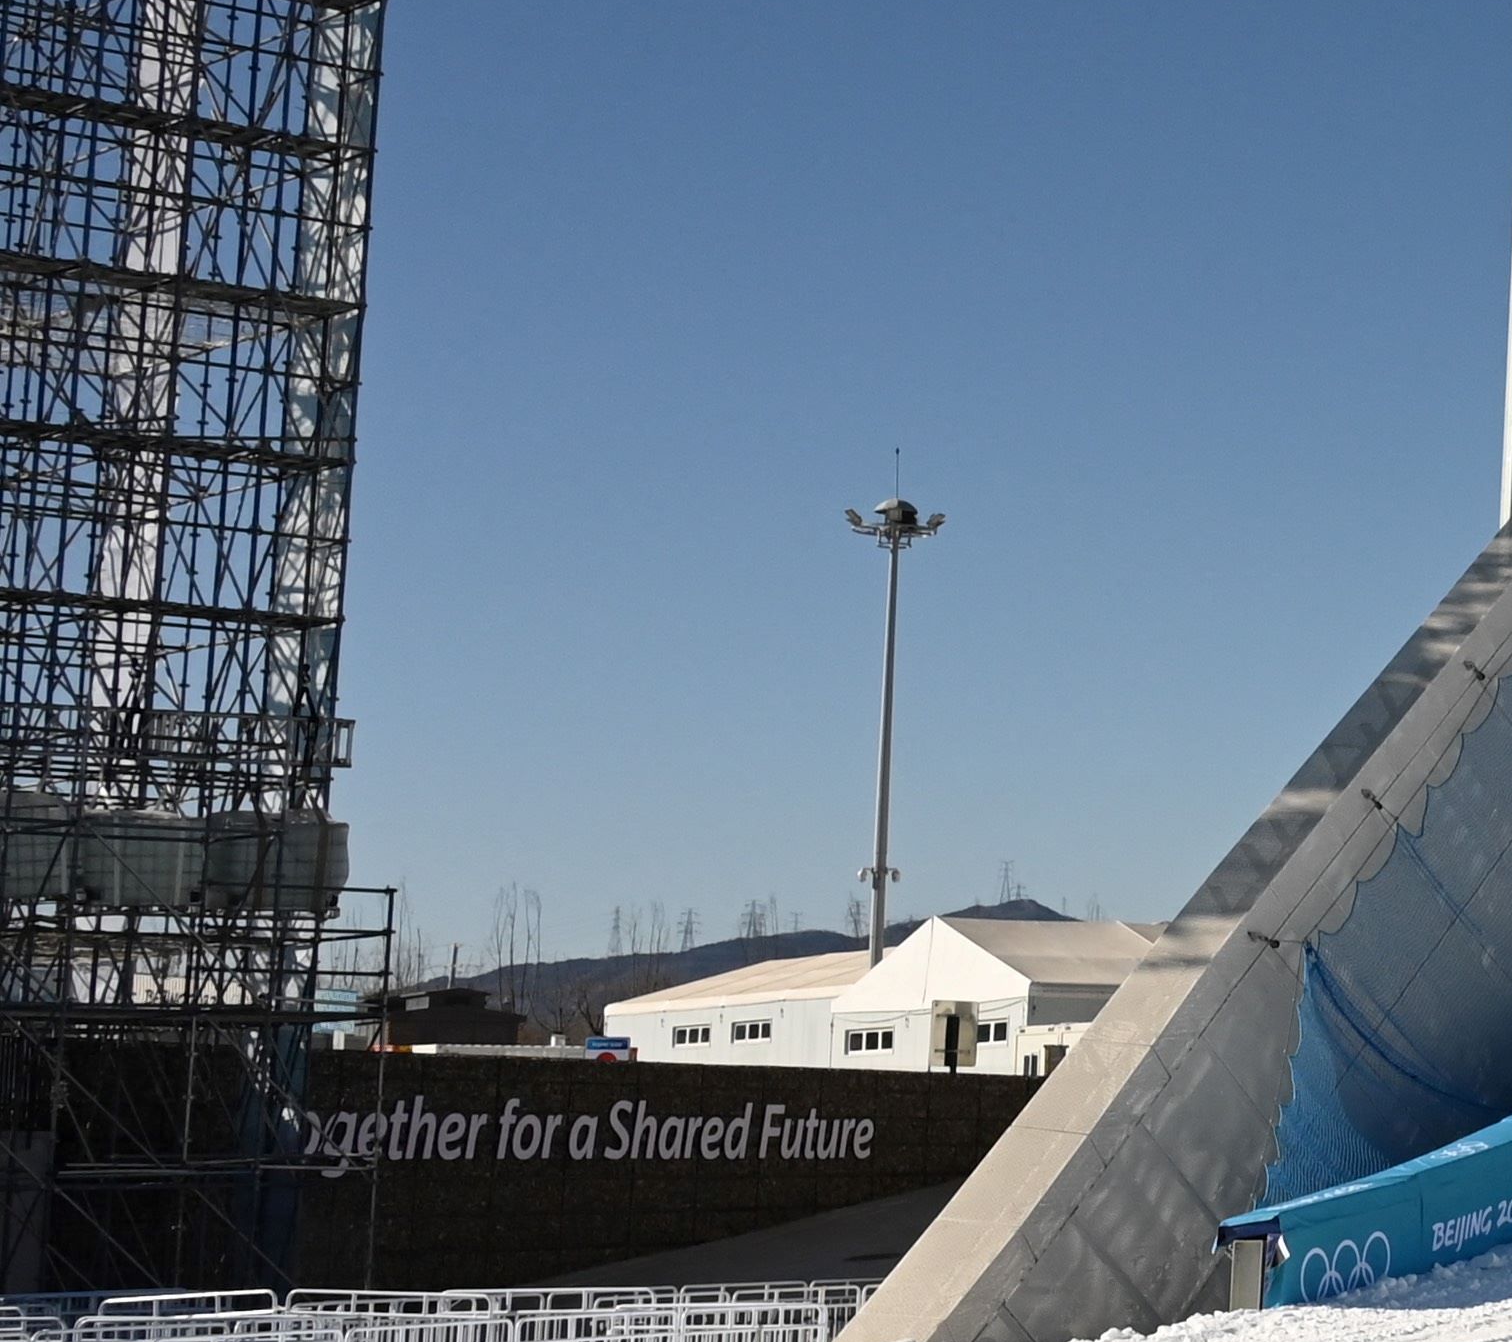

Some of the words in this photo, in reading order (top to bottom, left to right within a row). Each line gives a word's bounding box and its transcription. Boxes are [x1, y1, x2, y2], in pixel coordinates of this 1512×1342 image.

[498, 1098, 560, 1161] for
[568, 1113, 599, 1159] a
[604, 1100, 754, 1161] Shared
[759, 1103, 875, 1161] Future
[1432, 1206, 1493, 1253] BEIJING
